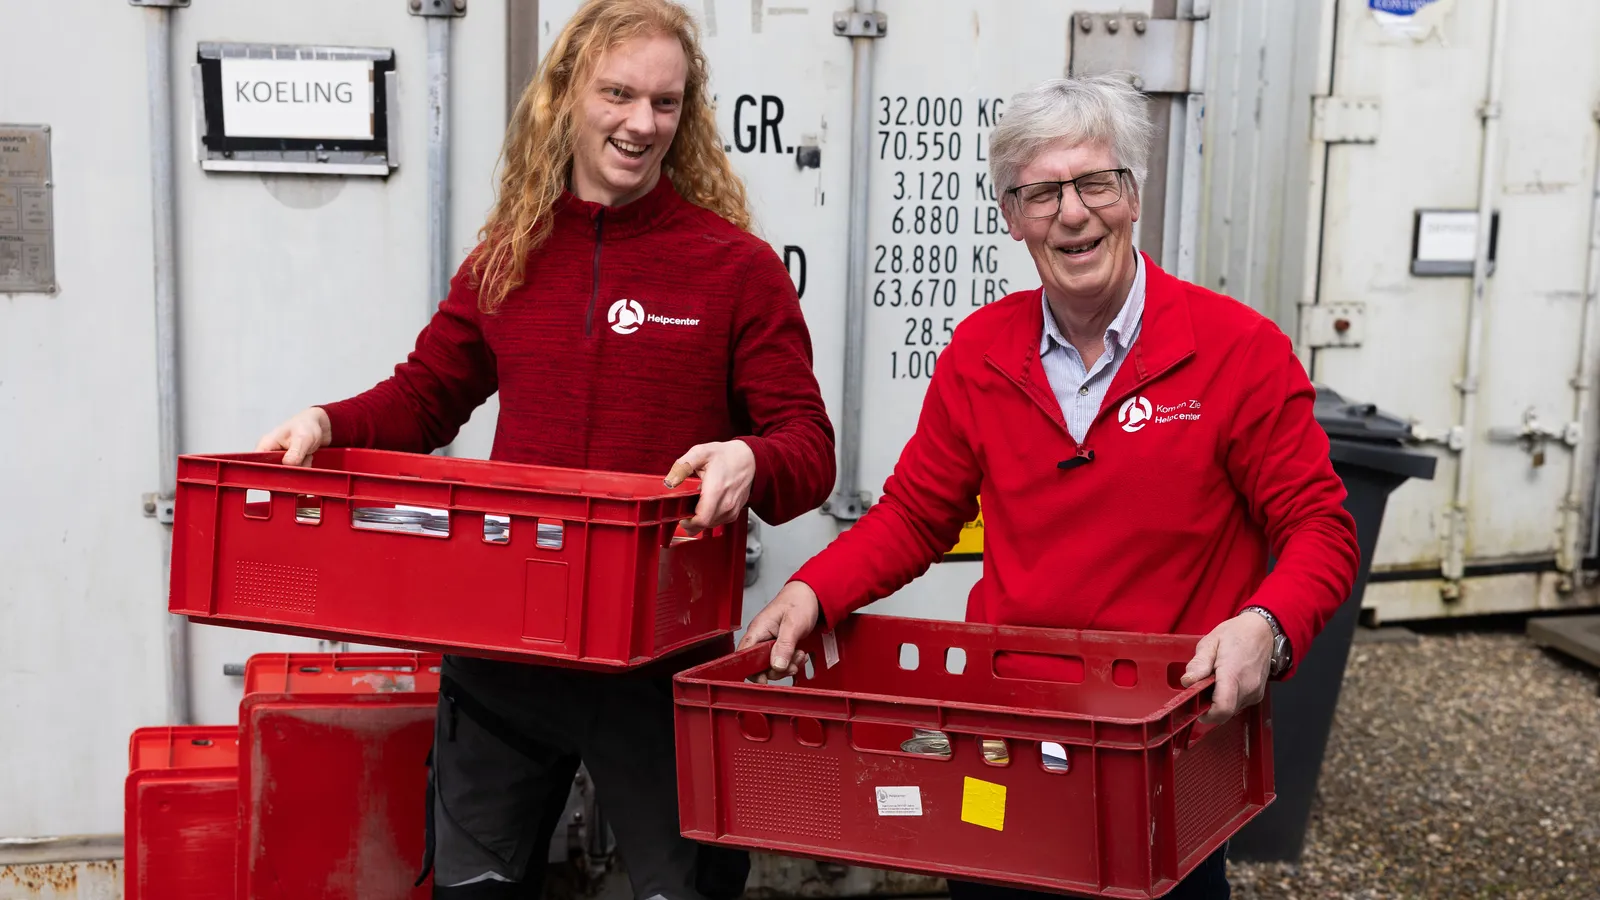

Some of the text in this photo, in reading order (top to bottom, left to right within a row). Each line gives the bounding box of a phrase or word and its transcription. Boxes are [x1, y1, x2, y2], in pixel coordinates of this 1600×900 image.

[236, 81, 353, 103] KOELING
[971, 245, 998, 274] KG
[971, 278, 1010, 307] LBS
[647, 313, 700, 326] Helpcenter
[1188, 399, 1202, 409] Zie
[1154, 412, 1202, 424] Helpcenter
